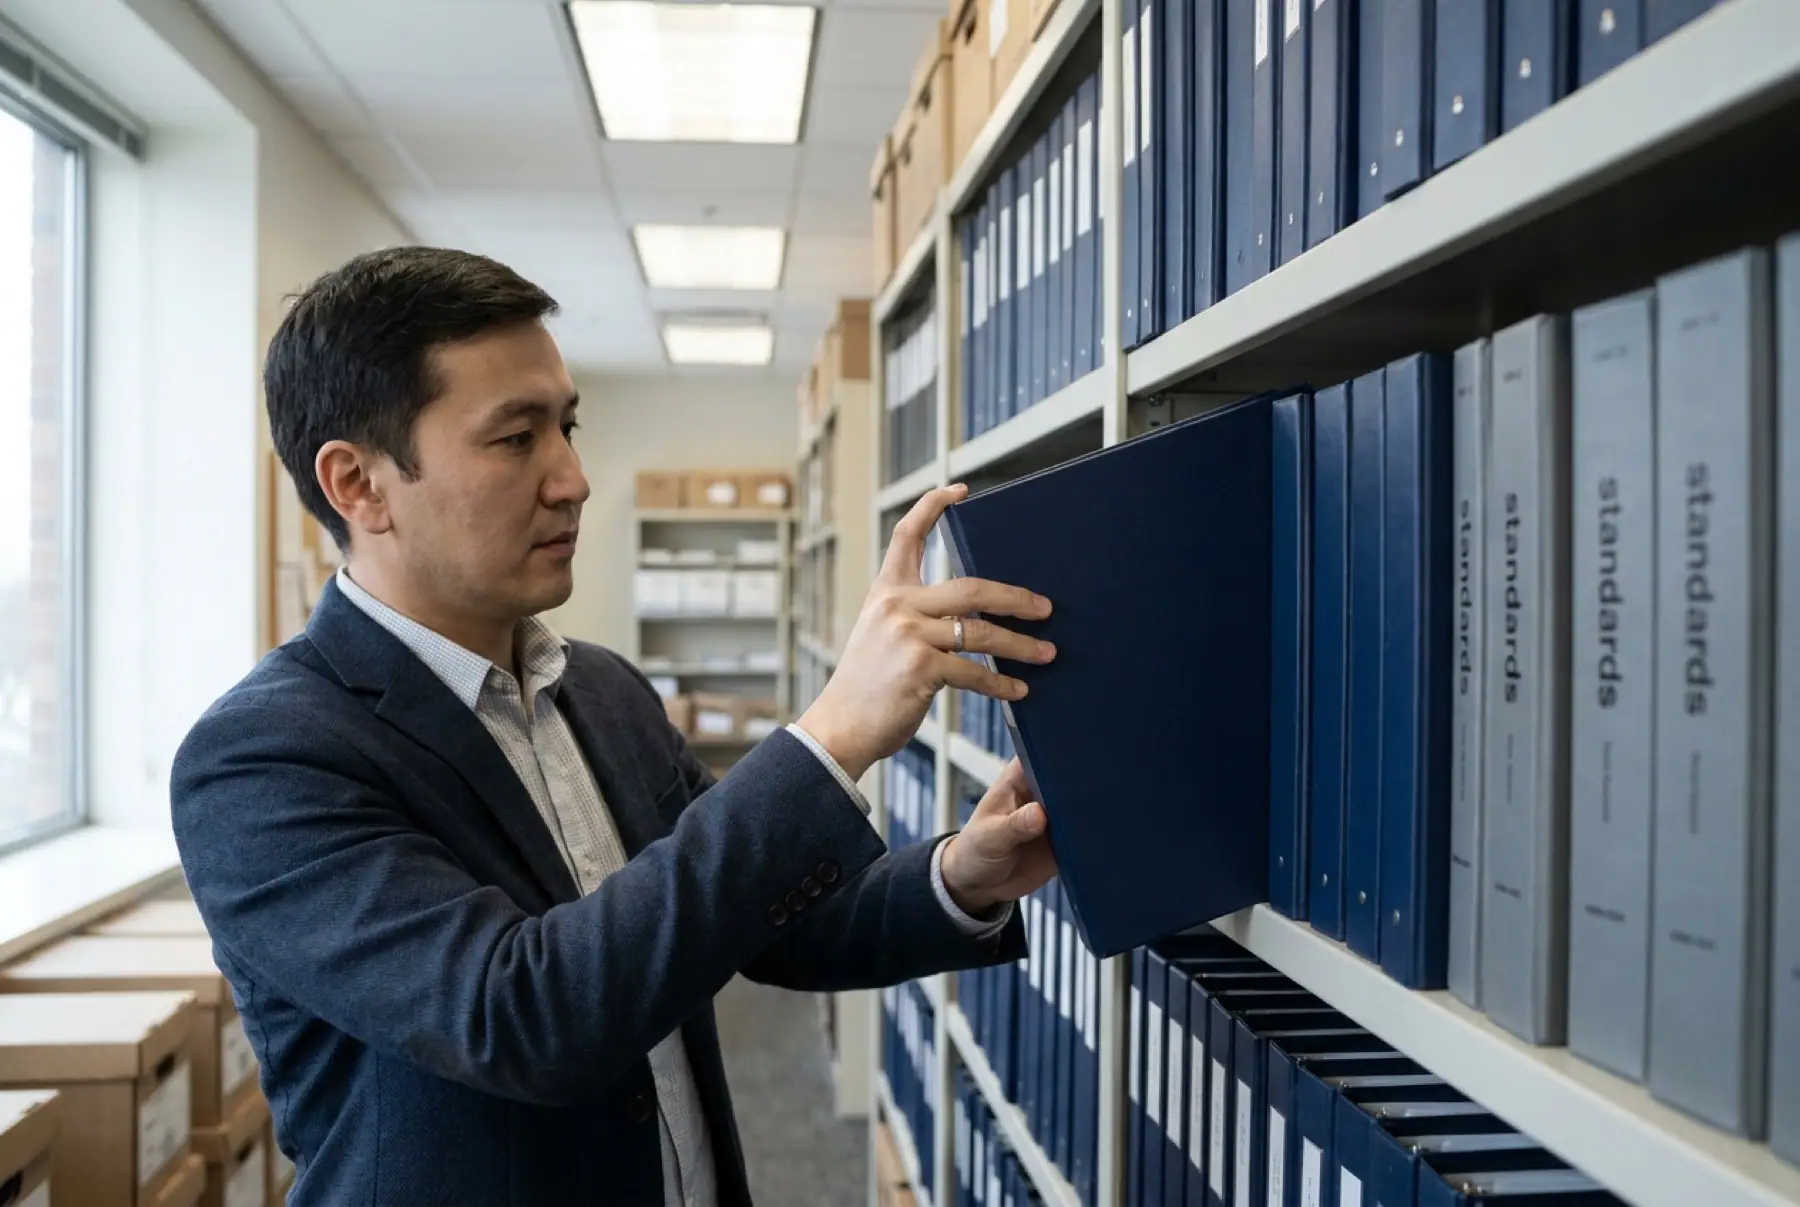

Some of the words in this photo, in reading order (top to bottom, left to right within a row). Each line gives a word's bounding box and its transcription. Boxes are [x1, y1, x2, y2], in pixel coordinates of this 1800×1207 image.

[1504, 492, 1522, 704] standards
[1598, 476, 1624, 708] standards
[1685, 463, 1715, 716] standards
